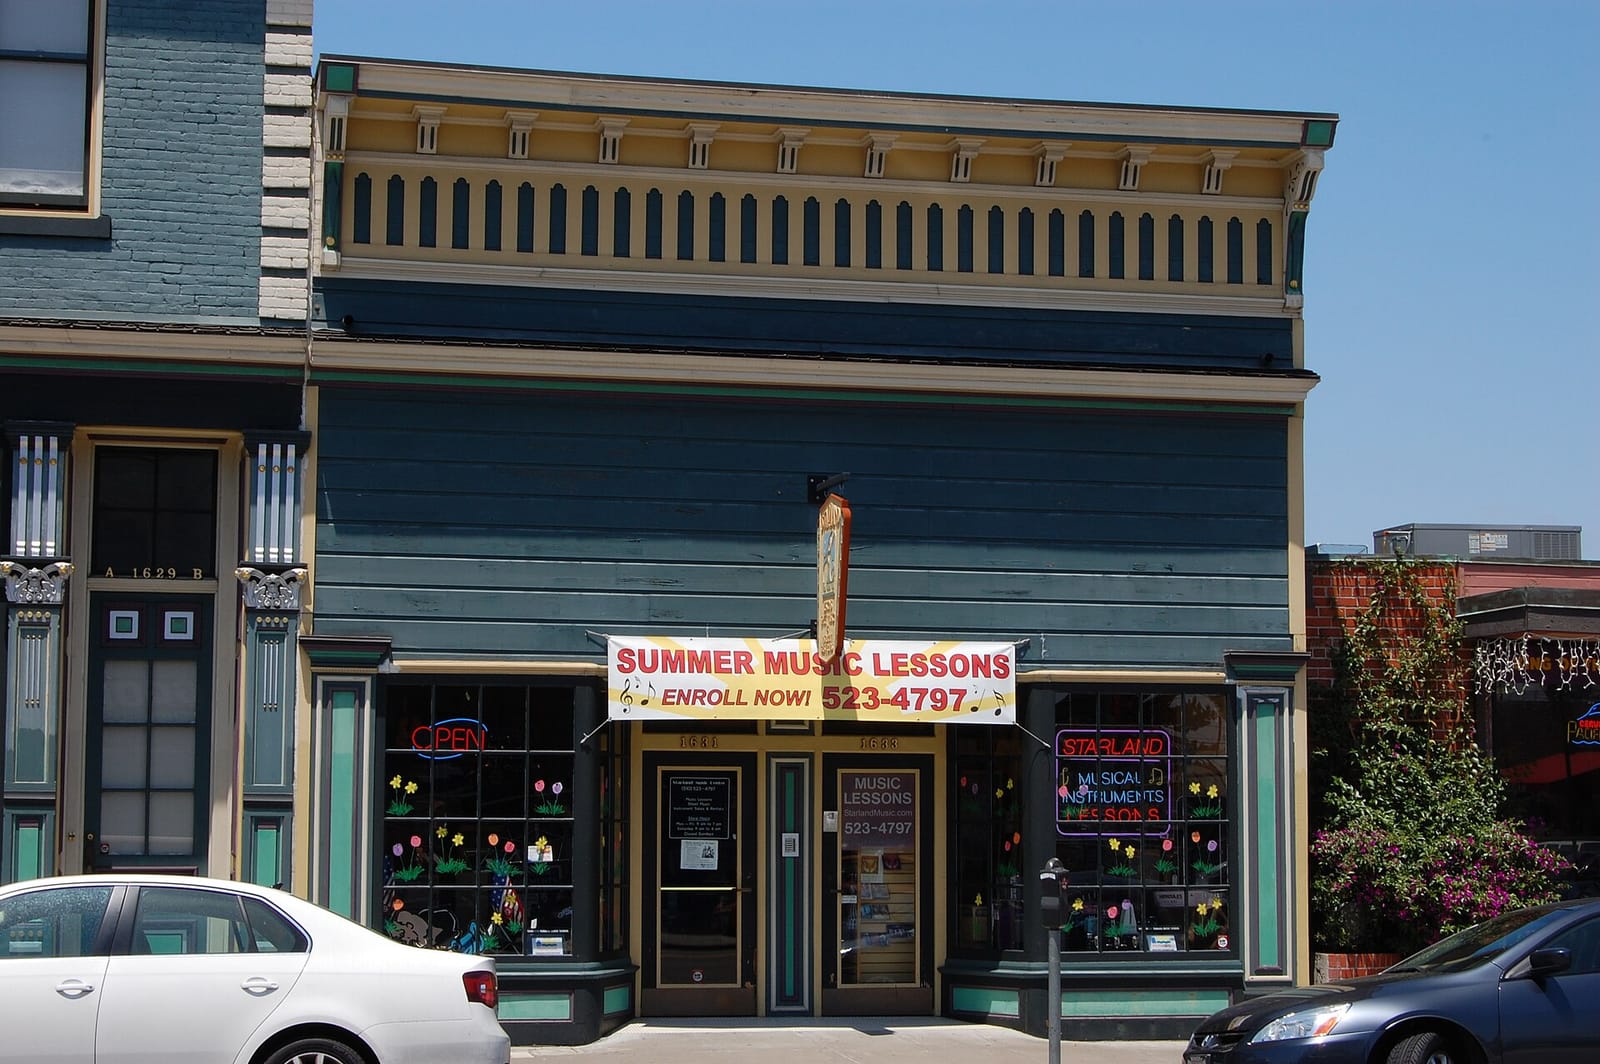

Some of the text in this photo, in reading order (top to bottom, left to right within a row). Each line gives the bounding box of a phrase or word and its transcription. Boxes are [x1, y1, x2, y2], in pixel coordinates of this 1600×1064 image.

[105, 566, 203, 579] A 1629 B
[617, 648, 1010, 679] SUMMER MUSIC LESSONS
[661, 686, 967, 712] ENROLL NOW! 523-4797
[411, 726, 485, 751] OPEN
[680, 736, 719, 748] 1631
[860, 738, 899, 749] 1633
[1063, 737, 1164, 755] STARLAND
[855, 777, 901, 789] MUSIC
[1078, 771, 1141, 785] MUSICAL
[844, 792, 912, 805] LESSONS
[1061, 789, 1165, 803] INSTRUMENTS
[844, 809, 912, 817] StarlandMusic.com
[844, 822, 912, 834] 523-4797
